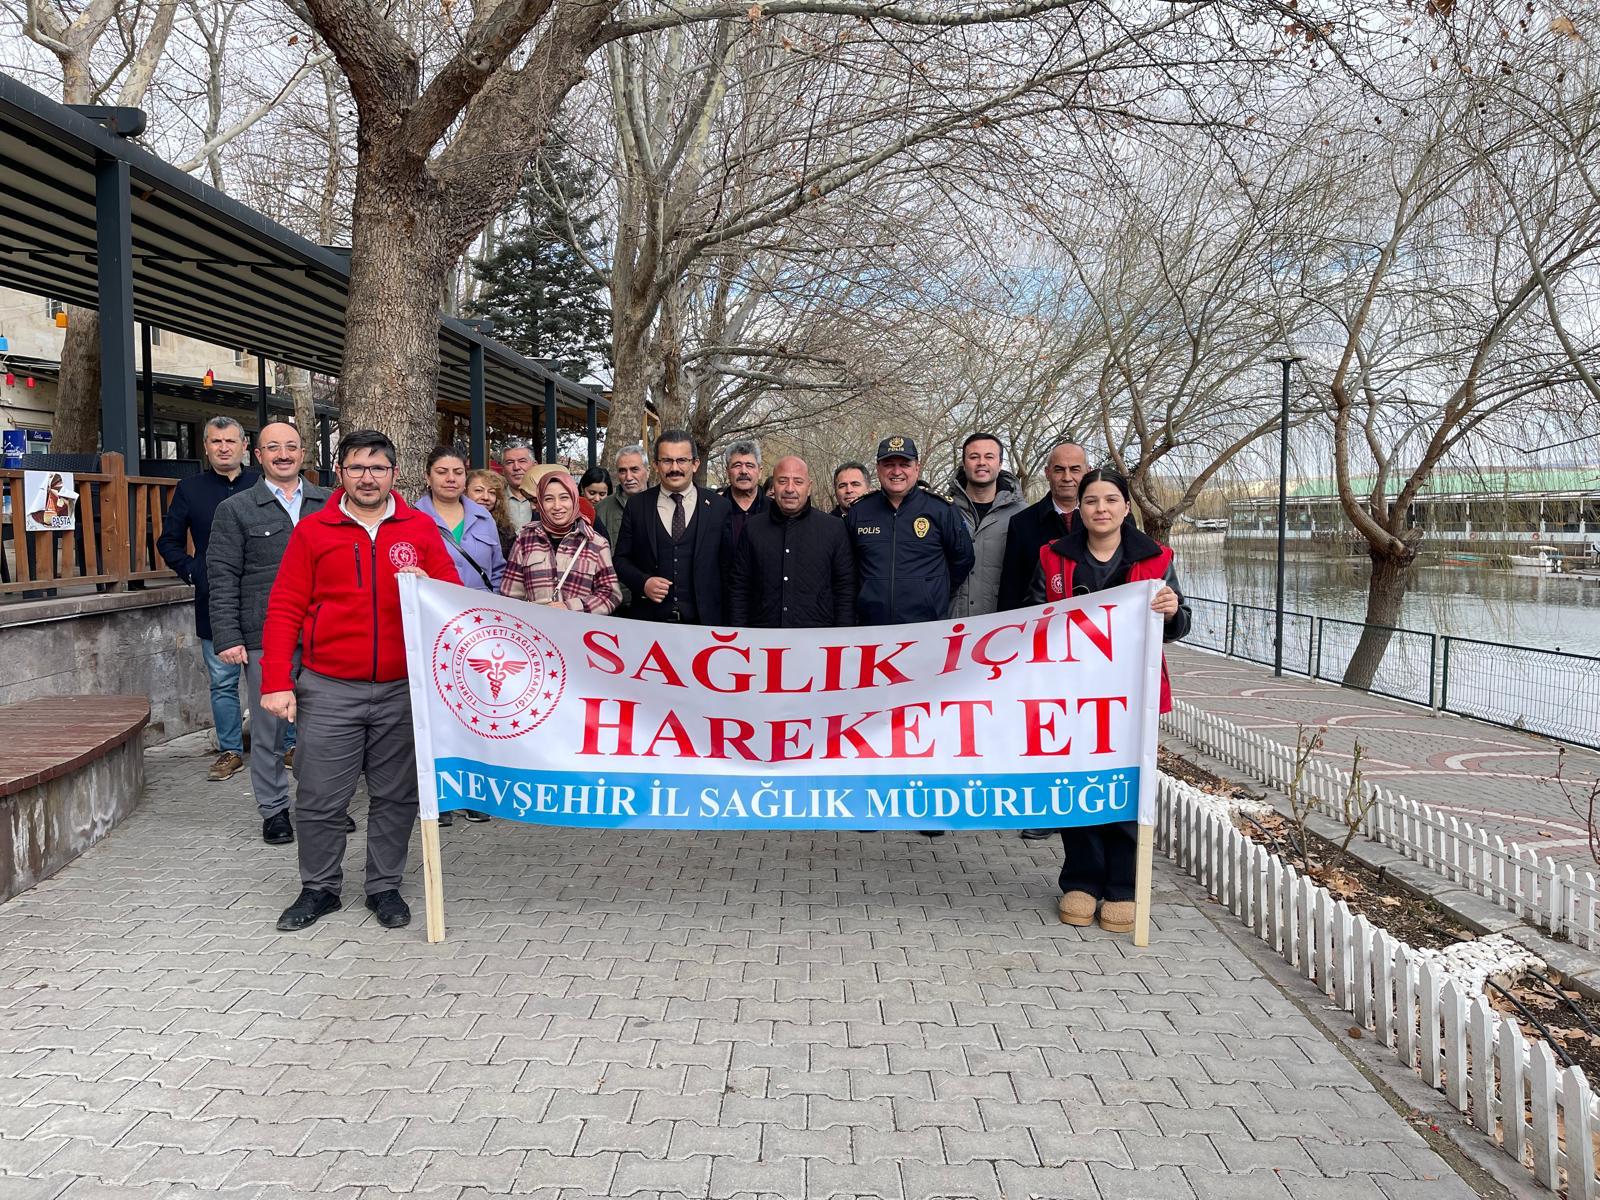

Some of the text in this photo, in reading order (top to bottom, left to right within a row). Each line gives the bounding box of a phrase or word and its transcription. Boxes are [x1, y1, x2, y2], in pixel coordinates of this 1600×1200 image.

[52, 516, 72, 526] PASTA
[456, 628, 508, 667] CUMHURİYETİ
[582, 604, 1118, 693] SAĞLIK İÇİN
[575, 696, 1128, 763] HAREKET ET
[437, 770, 1130, 818] NEVŞEHİR İL SAĞLIK MÜDÜRLÜĞÜ
